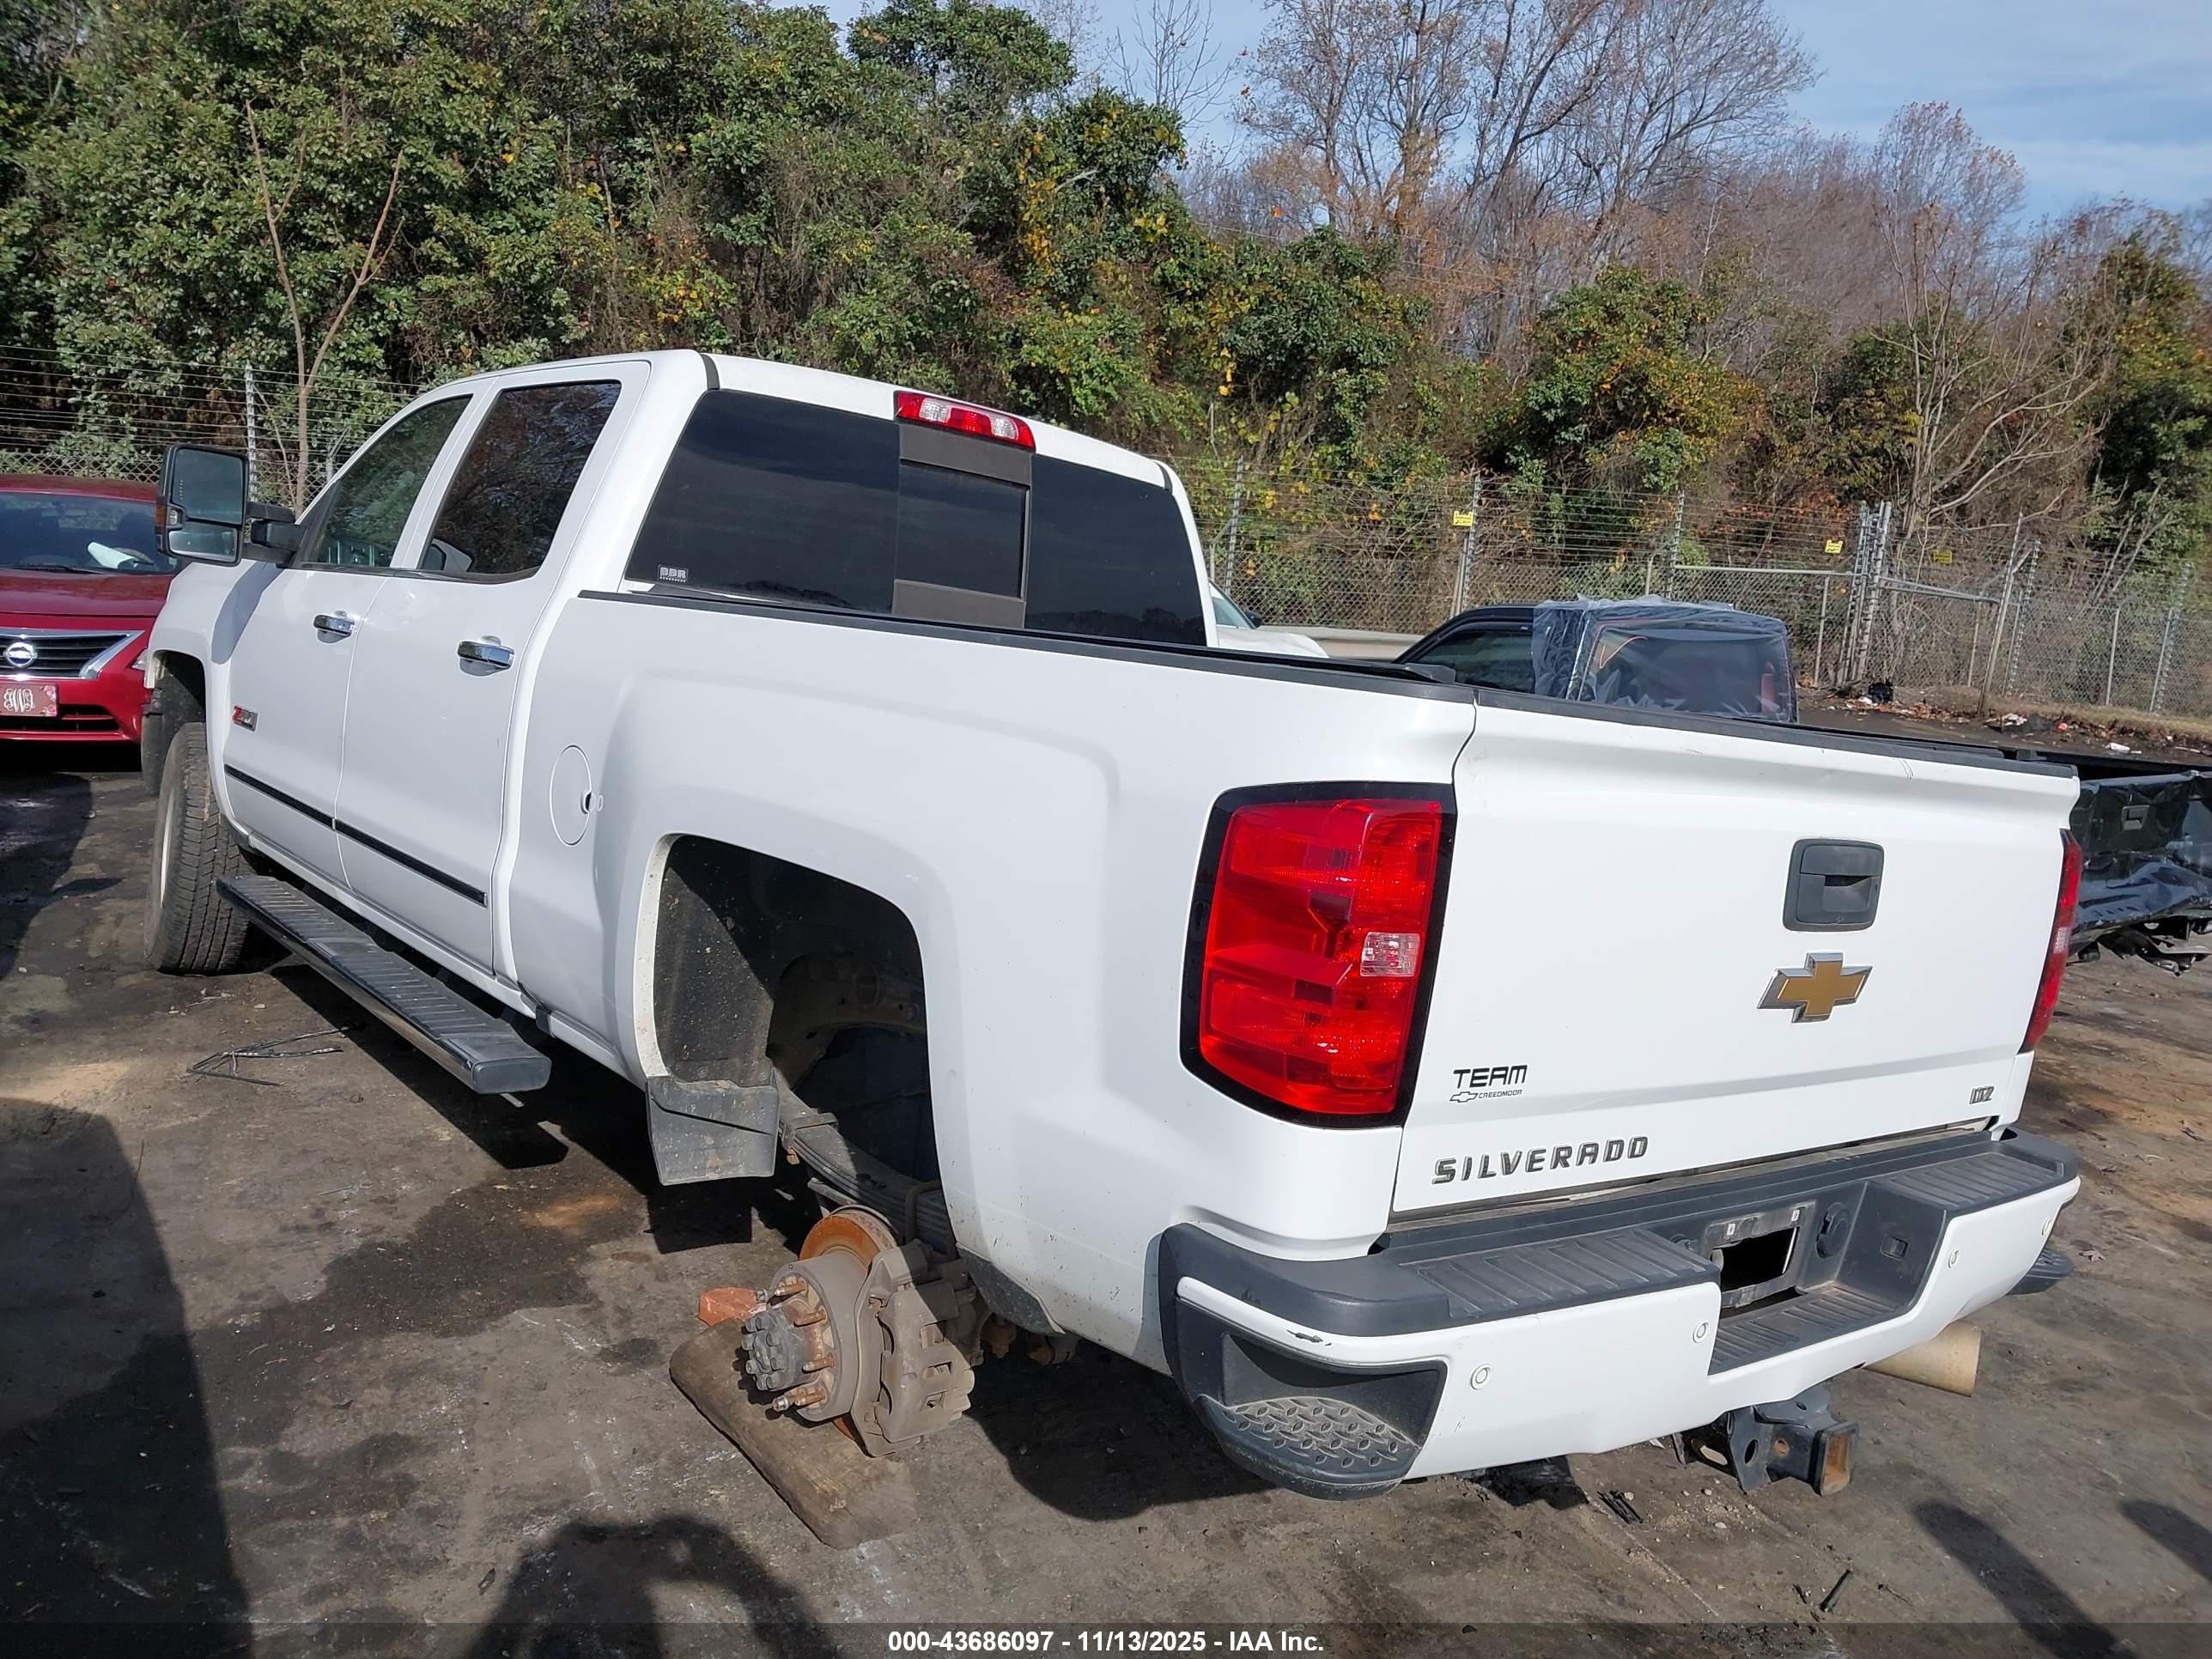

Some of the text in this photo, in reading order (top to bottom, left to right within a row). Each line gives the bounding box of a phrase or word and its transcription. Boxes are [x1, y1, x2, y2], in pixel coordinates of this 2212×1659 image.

[1453, 1064, 1528, 1089] TEAM
[1478, 1089, 1522, 1099] CREEDMOOR
[1431, 1135, 1649, 1185] SILVERADO
